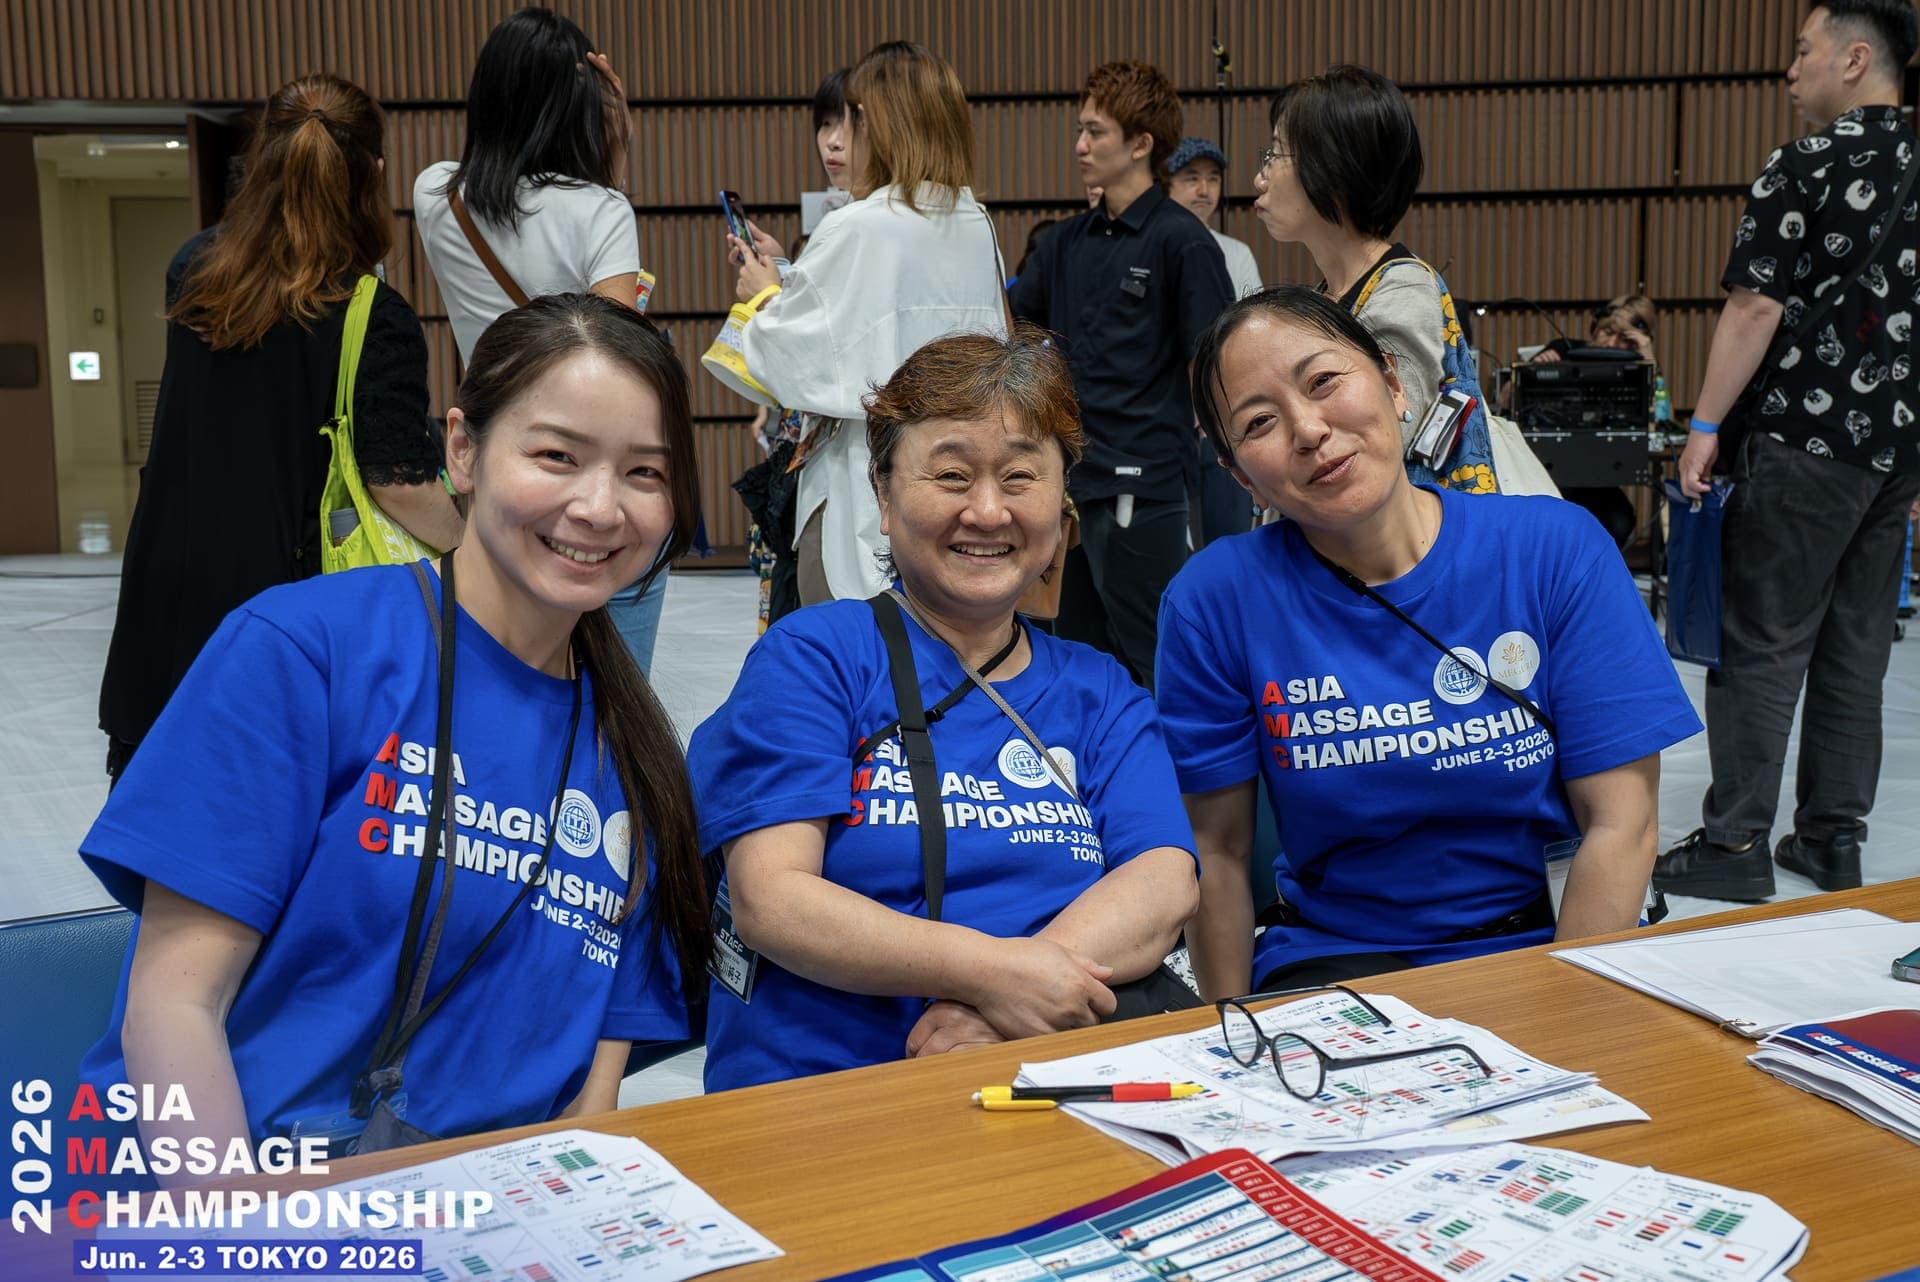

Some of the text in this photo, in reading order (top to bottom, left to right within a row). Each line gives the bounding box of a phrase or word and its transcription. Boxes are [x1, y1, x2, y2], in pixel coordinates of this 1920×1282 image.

[1262, 675, 1346, 706] ASIA
[1263, 699, 1434, 738] MASSAGE
[1271, 701, 1541, 770] CHAMPIONSHIP
[1432, 752, 1482, 772] JUNE
[1516, 730, 1549, 755] 2026
[1504, 743, 1555, 772] TOKYO
[852, 765, 1005, 801] MASAGE
[363, 772, 547, 847] MASAGE
[1008, 829, 1055, 844] JUNE
[531, 895, 571, 926] JNE
[594, 925, 621, 951] 202
[720, 928, 743, 953] STAFF
[582, 938, 619, 969] TOKY
